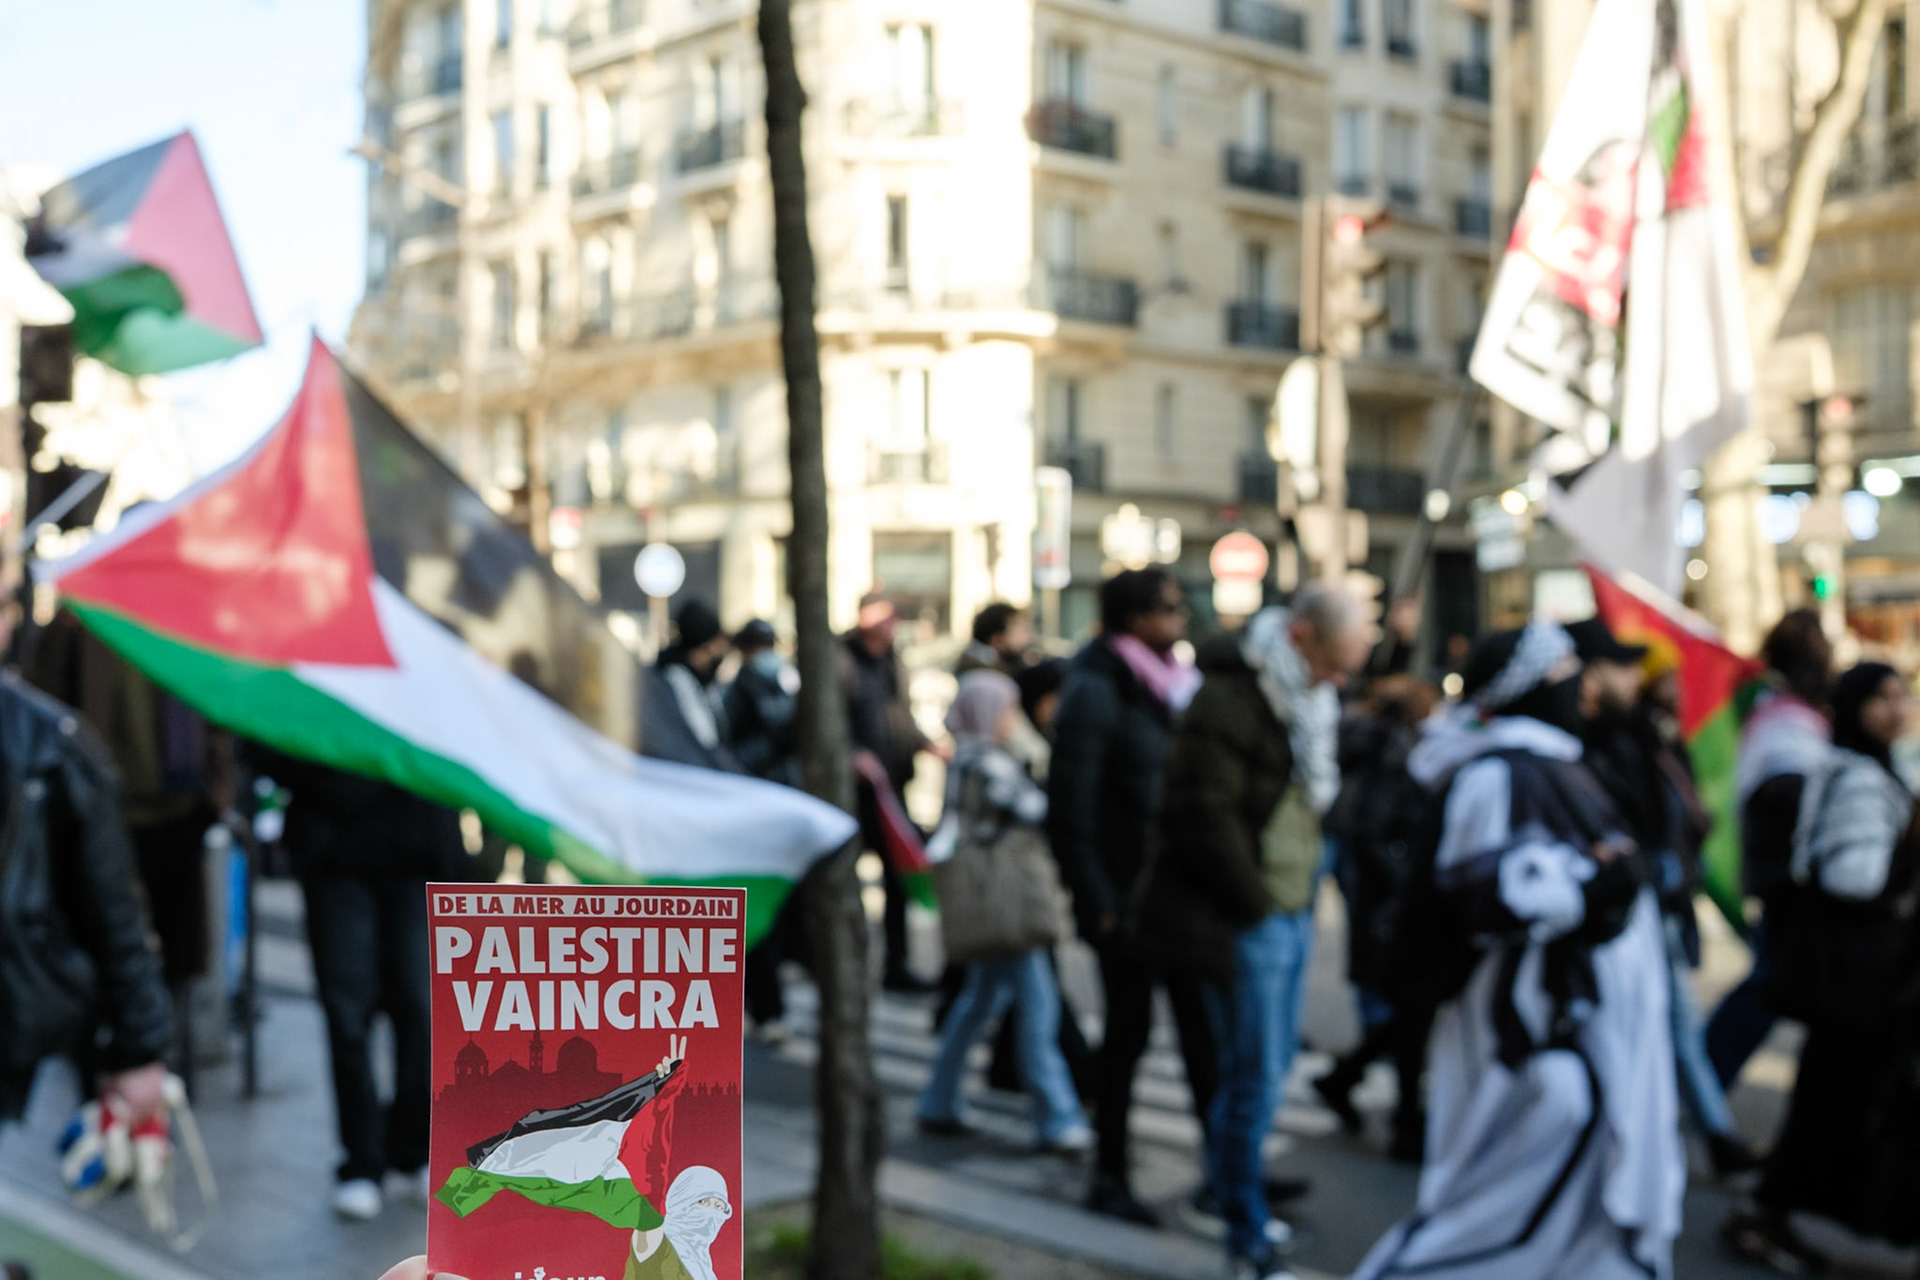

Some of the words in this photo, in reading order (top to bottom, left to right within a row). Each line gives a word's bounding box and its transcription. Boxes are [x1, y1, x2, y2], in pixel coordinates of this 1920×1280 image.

[438, 896, 467, 914] DE
[476, 896, 504, 915] LA
[513, 896, 564, 915] MER
[573, 897, 606, 915] AU
[613, 898, 733, 916] JOURDAIN
[435, 926, 737, 974] PALESTINE
[452, 979, 720, 1031] VAINCRA
